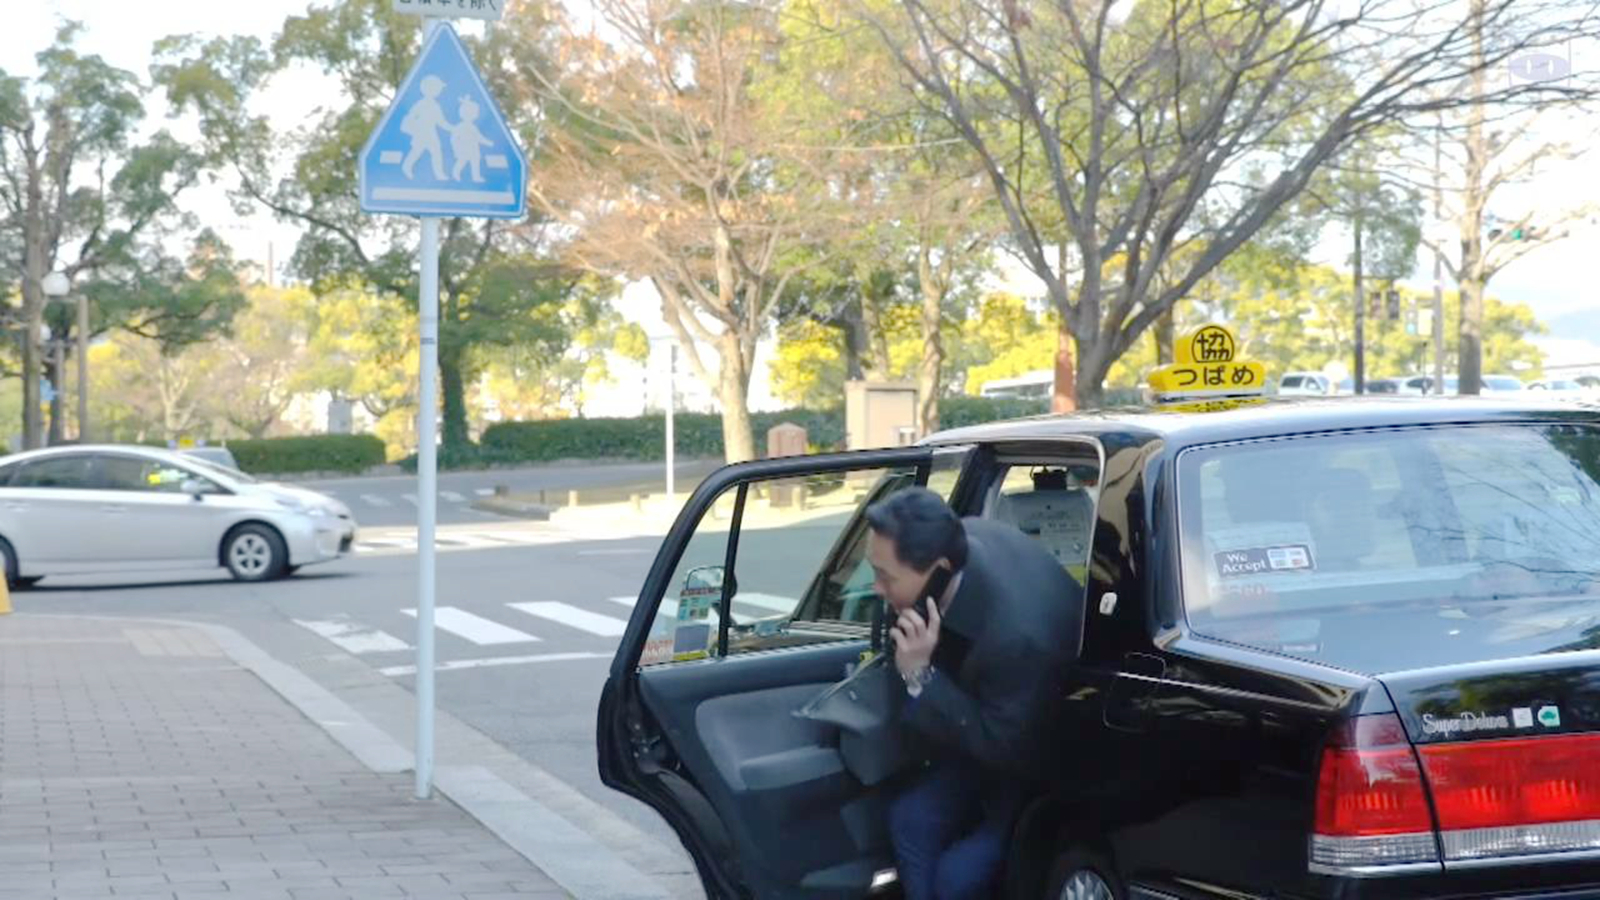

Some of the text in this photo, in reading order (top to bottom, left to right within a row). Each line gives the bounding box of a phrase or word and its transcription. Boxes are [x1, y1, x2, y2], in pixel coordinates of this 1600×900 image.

[1196, 331, 1230, 360] 協
[1173, 365, 1254, 386] つばめ
[1222, 559, 1268, 573] Accept
[1226, 553, 1249, 563] We
[1422, 713, 1461, 738] Super
